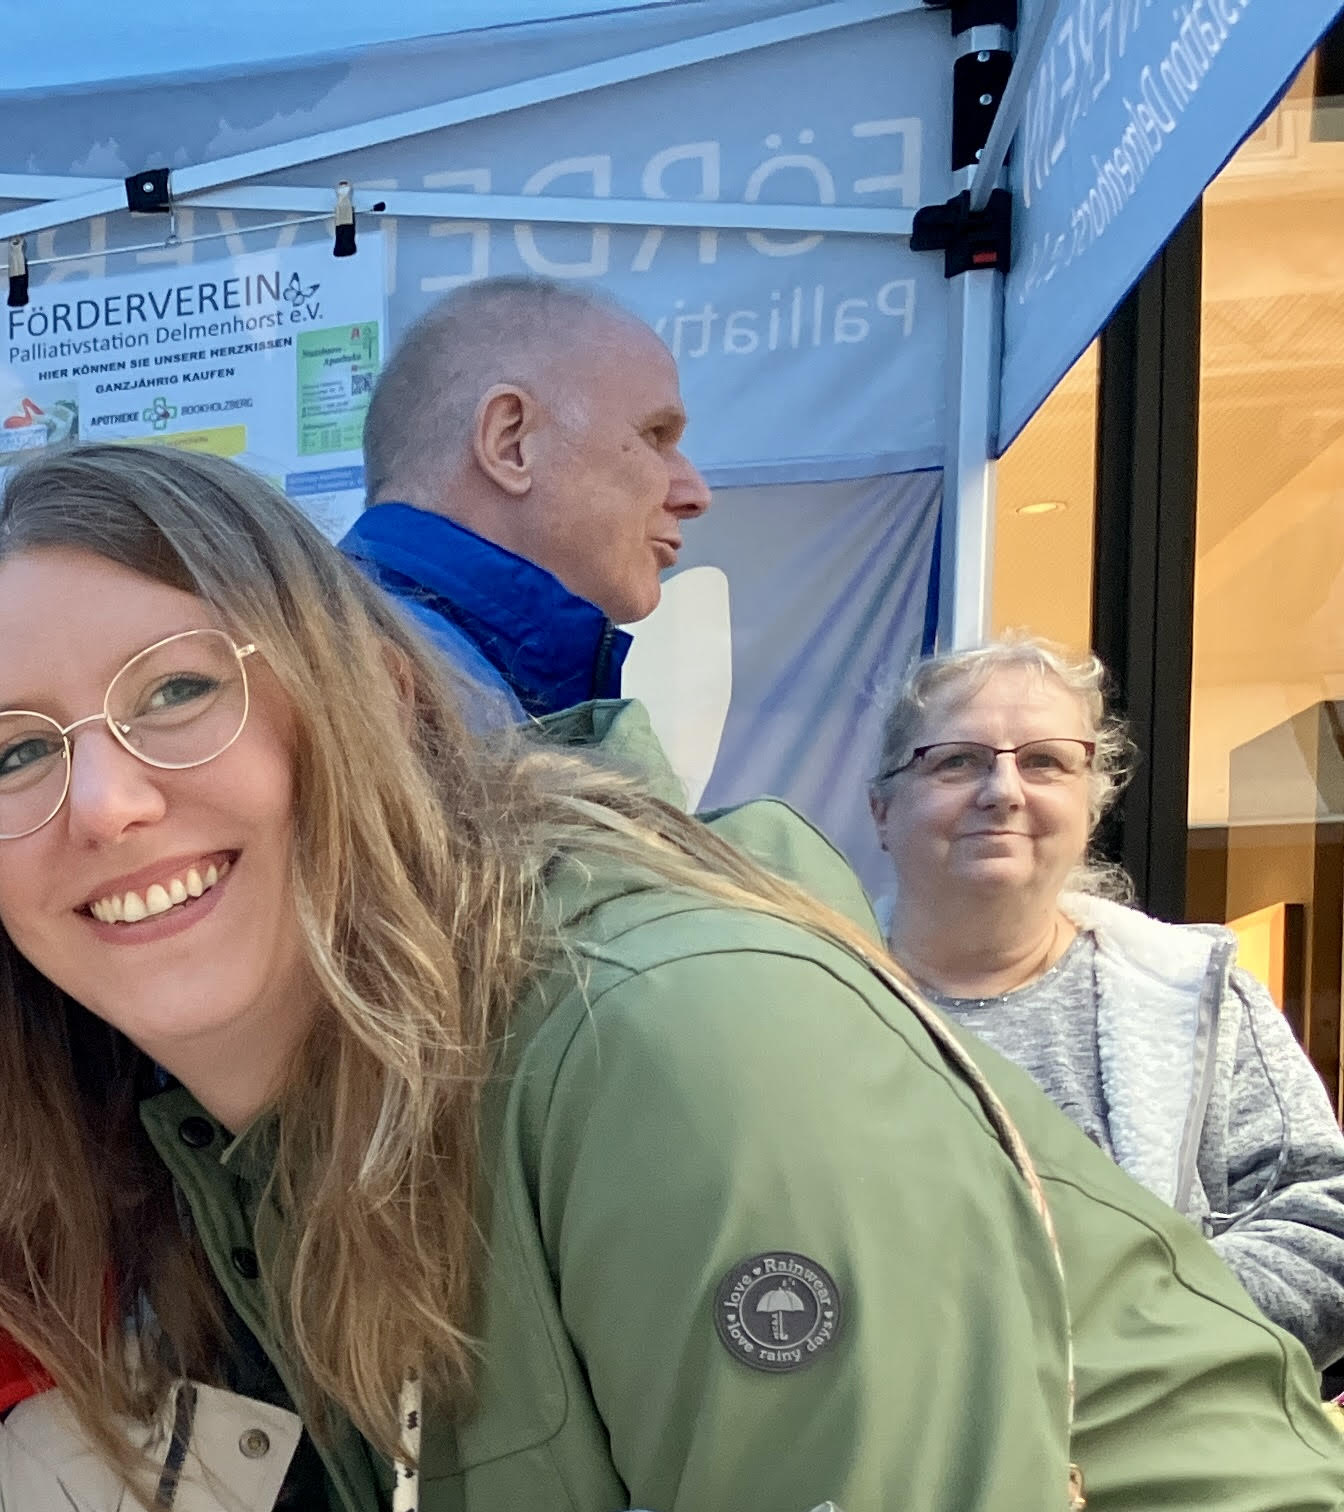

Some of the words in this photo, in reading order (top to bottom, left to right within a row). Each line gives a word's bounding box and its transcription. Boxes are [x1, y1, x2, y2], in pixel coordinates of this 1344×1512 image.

[9, 331, 150, 365] Palliativstation
[155, 310, 285, 345] Delmenhorst
[289, 301, 325, 324] e.V.
[38, 367, 69, 382] HIER
[72, 359, 127, 378] KÖNNEN
[130, 355, 152, 370] SIE
[154, 349, 207, 367] UNSERE
[209, 335, 294, 361] HERZKISSEN
[94, 374, 180, 395] GANZJÄHRIG
[182, 367, 235, 383] KAUFEN
[723, 1275, 753, 1309] love
[763, 1259, 832, 1306] Rainwear
[727, 1322, 754, 1353] love
[758, 1349, 802, 1362] rainy
[806, 1321, 833, 1352] days
